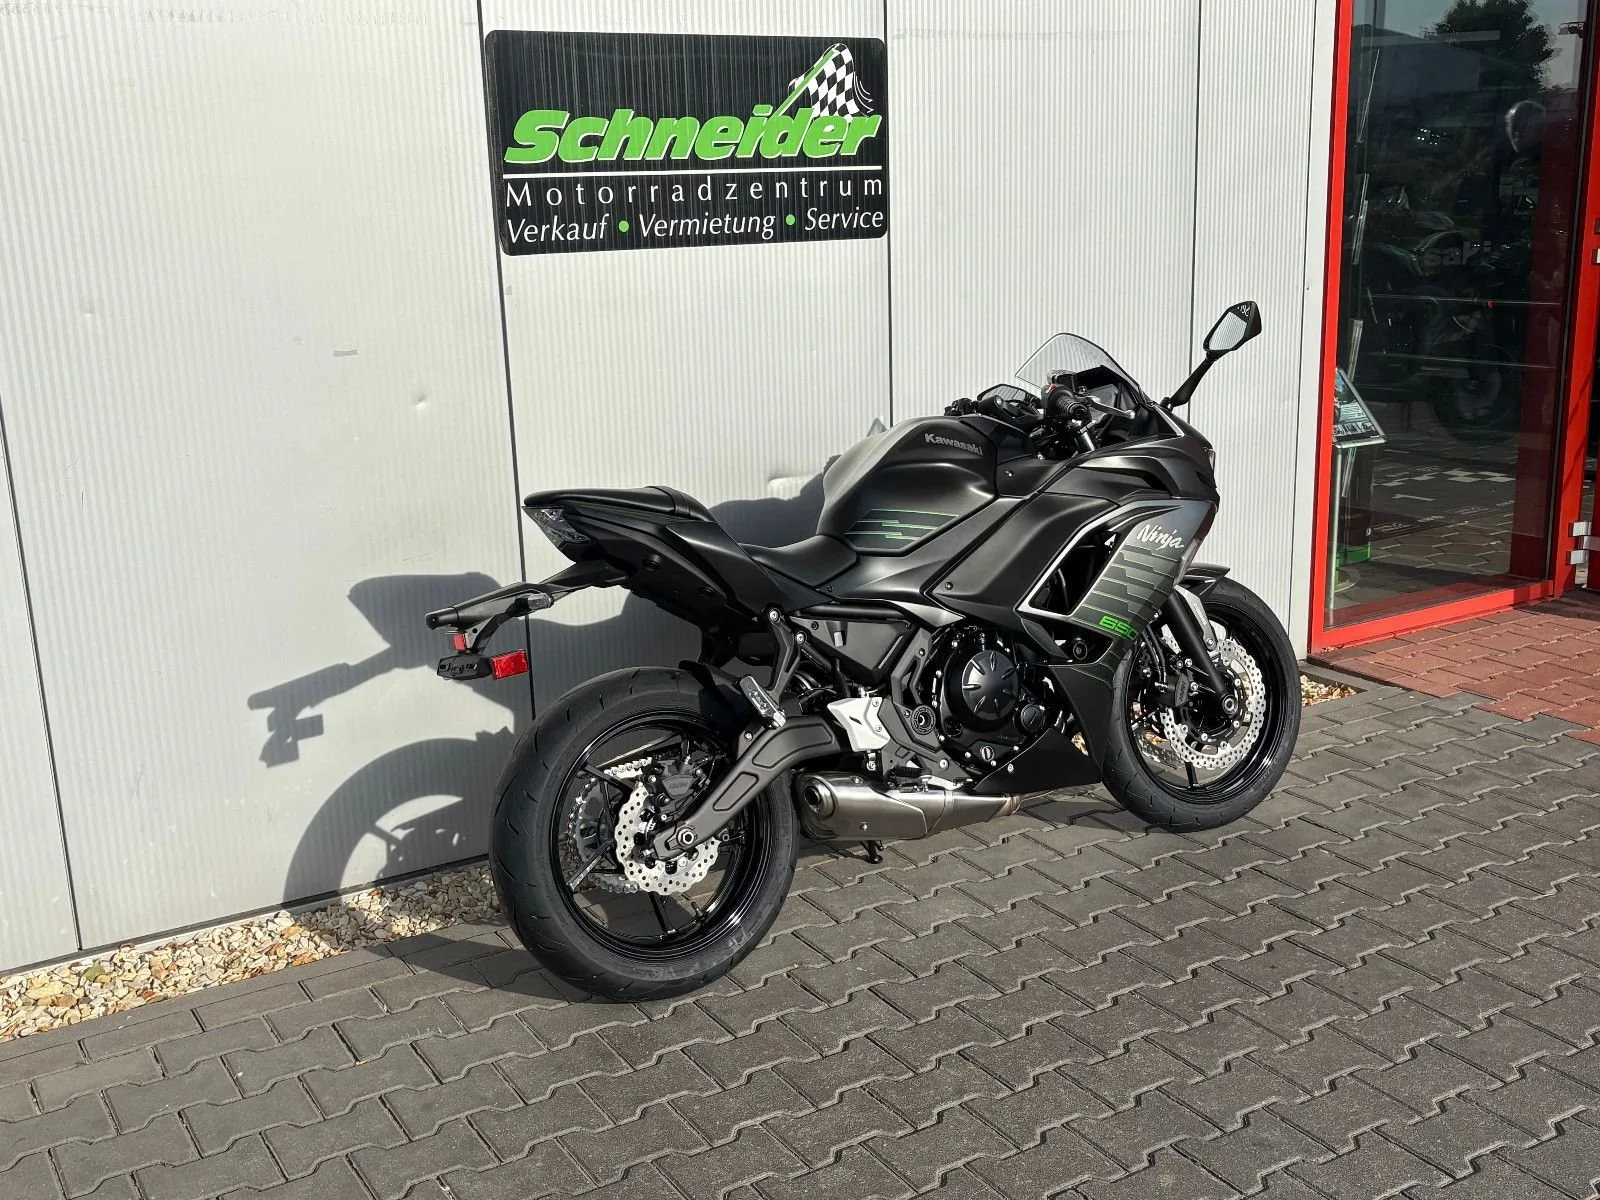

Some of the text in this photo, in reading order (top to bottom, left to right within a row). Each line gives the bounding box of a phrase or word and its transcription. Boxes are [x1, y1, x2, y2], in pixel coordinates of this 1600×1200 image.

[504, 104, 882, 163] Schneider
[506, 176, 882, 208] Motorradzentrum
[507, 206, 884, 243] Verkauf Vermietung Service
[924, 433, 983, 456] Kawasaki
[1136, 524, 1184, 550] Ninja
[1099, 615, 1139, 641] 650
